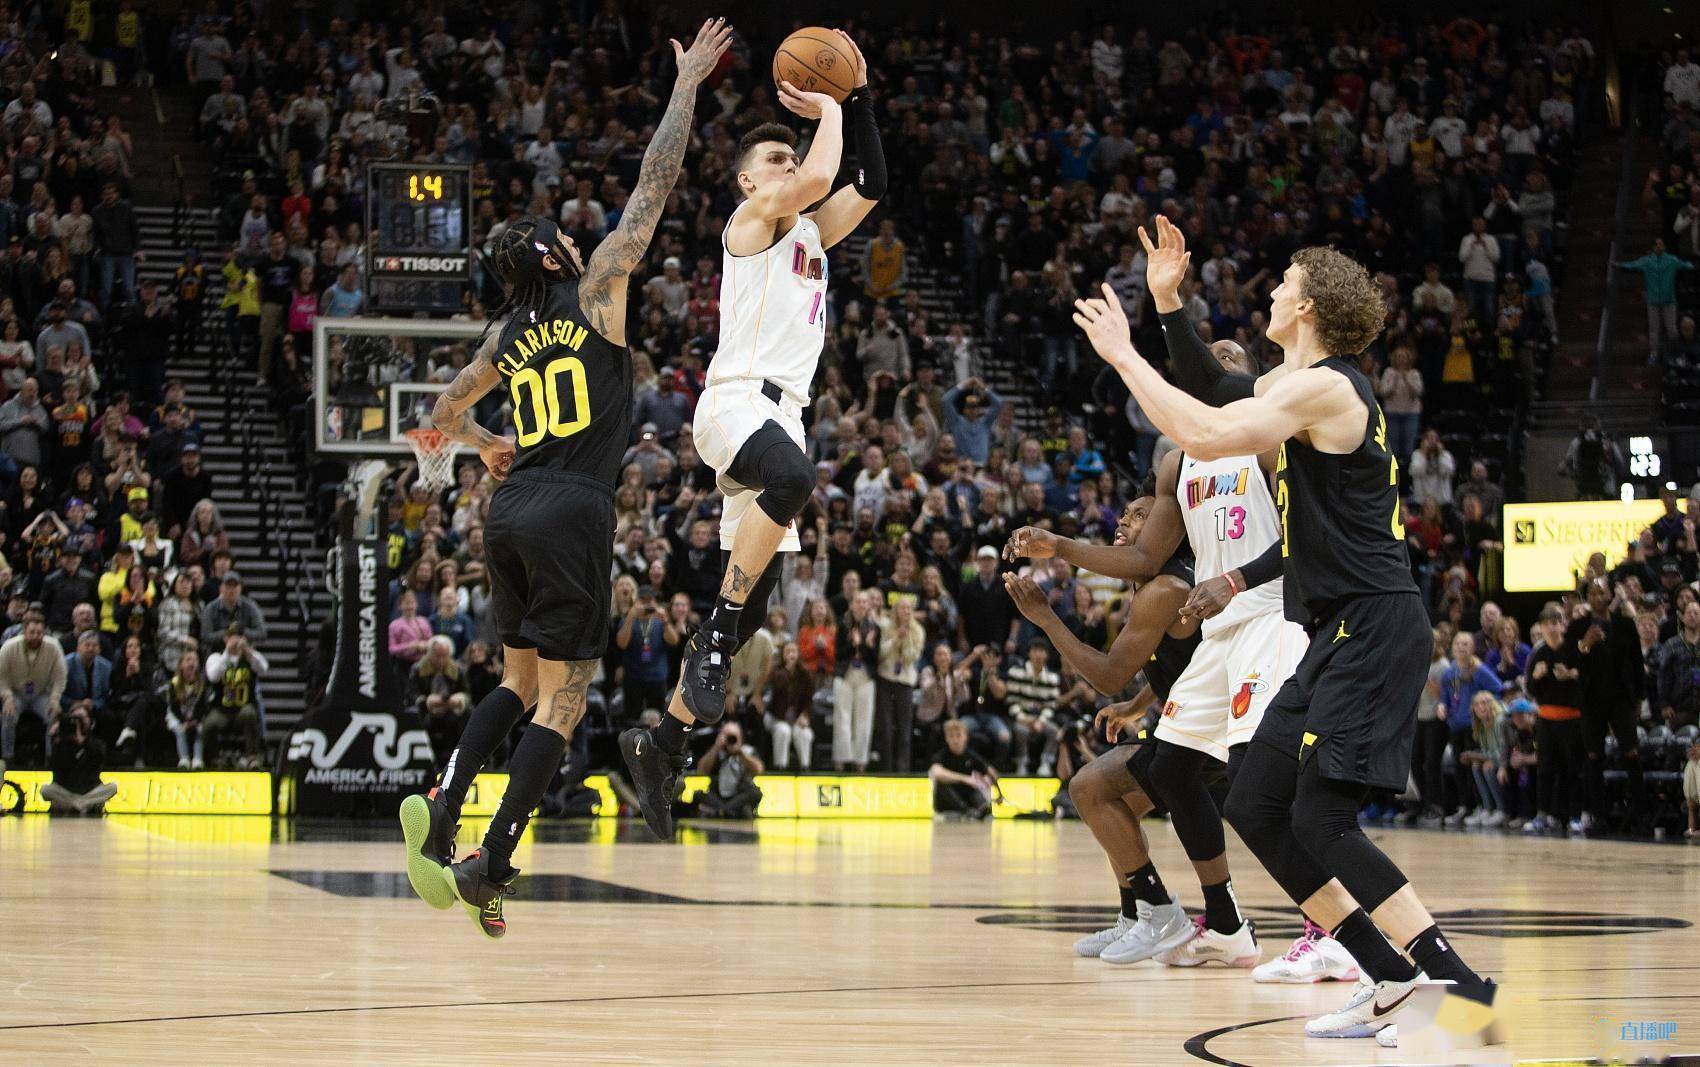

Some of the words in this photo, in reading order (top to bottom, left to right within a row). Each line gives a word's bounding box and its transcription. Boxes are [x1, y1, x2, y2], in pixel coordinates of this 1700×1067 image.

[410, 174, 442, 201] 1.4
[400, 257, 467, 272] TISSOT
[498, 319, 588, 377] CLARKSON
[510, 356, 592, 448] 00
[1186, 467, 1249, 511] MIAMI
[1214, 505, 1246, 542] 13
[357, 543, 377, 603] FIRST
[358, 603, 377, 699] AMERICA
[304, 768, 377, 784] AMERICA
[379, 768, 426, 785] FIRST
